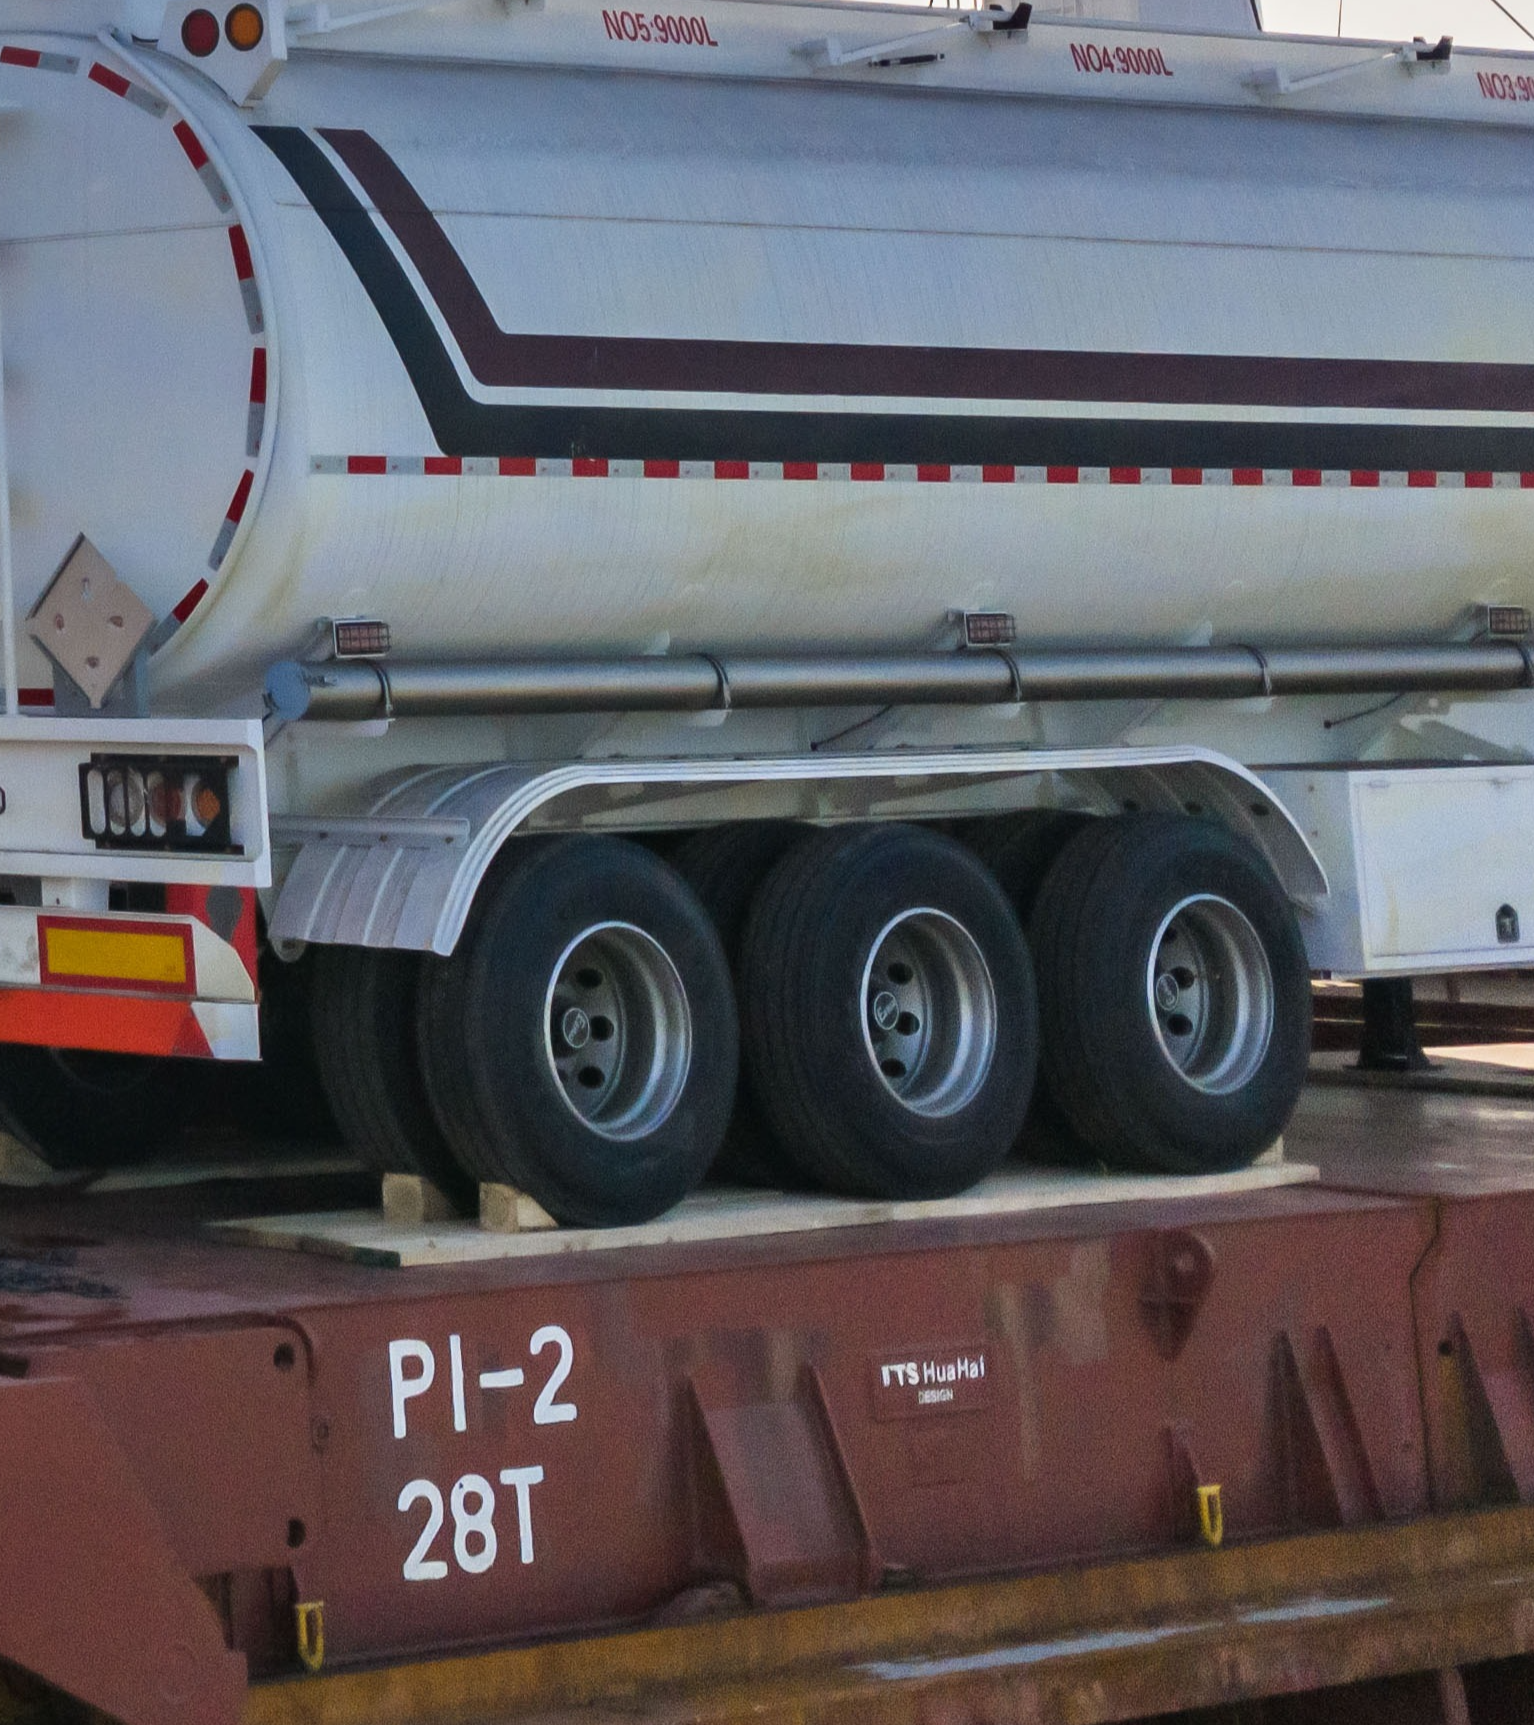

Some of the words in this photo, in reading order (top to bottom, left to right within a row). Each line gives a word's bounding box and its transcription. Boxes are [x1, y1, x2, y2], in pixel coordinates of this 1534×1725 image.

[602, 10, 719, 47] NO5:9000L
[1070, 43, 1174, 76] NO4:9000L
[918, 1388, 954, 1405] DESIGN
[398, 1465, 544, 1581] 28T
